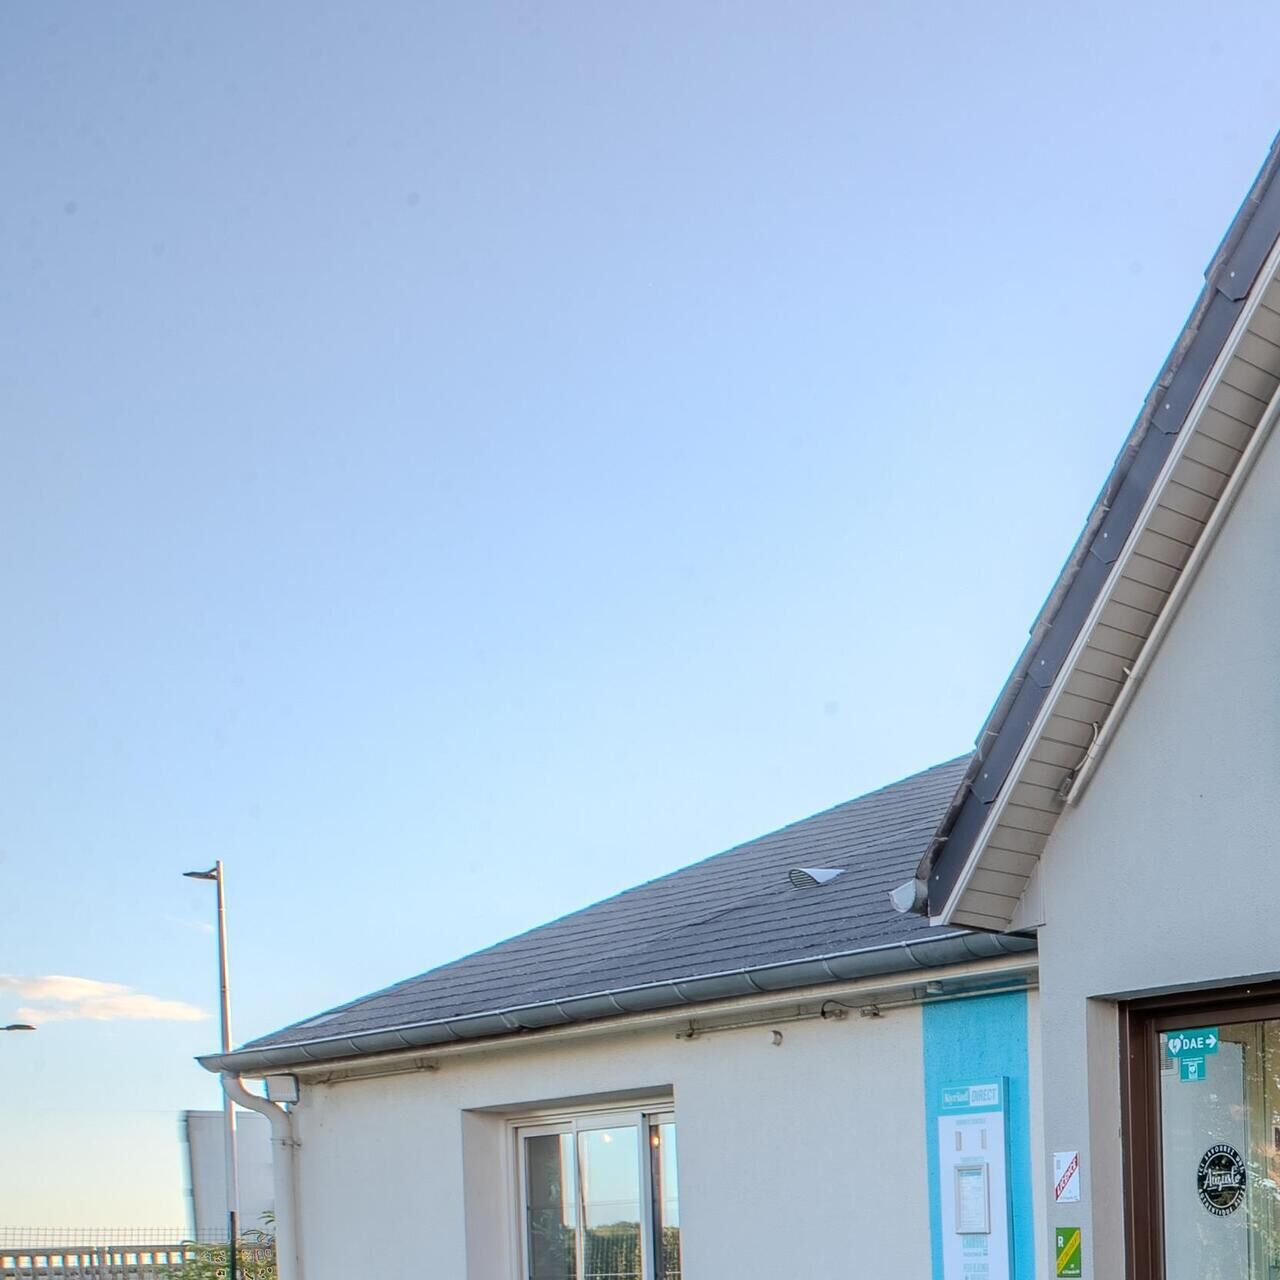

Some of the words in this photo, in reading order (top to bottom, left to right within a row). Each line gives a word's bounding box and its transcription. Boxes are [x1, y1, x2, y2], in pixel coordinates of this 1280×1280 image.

[1182, 1037, 1204, 1050] DAE
[1203, 1165, 1242, 1192] Augusto
[1057, 1235, 1064, 1248] R
